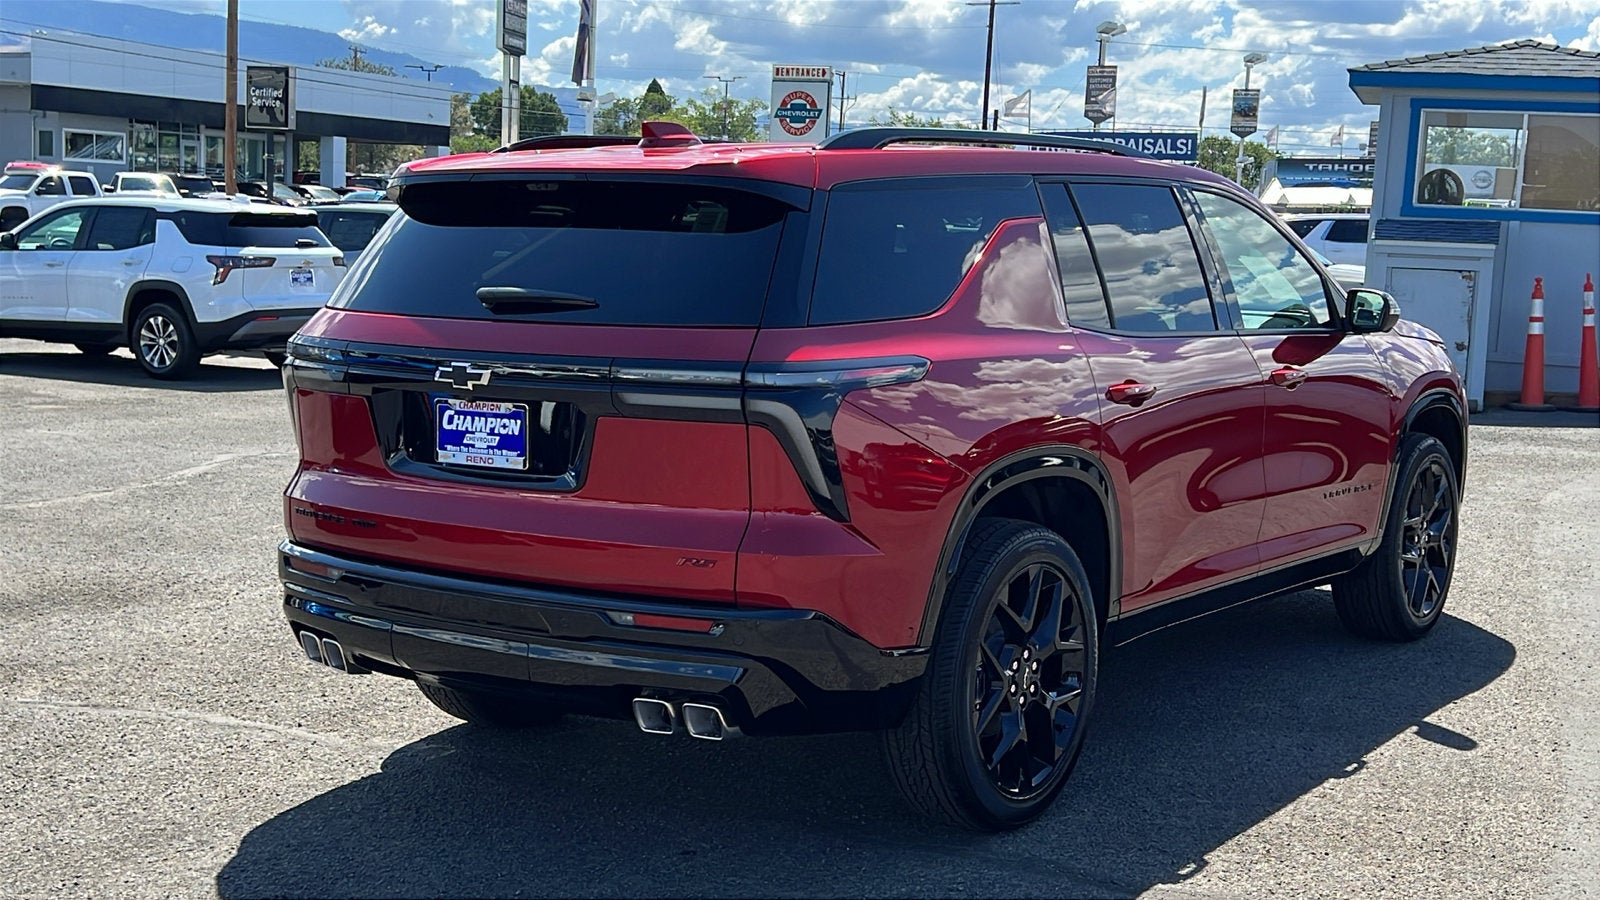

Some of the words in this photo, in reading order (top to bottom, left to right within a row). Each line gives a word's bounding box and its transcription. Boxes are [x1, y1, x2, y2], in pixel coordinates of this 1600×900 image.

[780, 67, 821, 77] ENTRANCE
[250, 87, 283, 97] Certified
[252, 97, 280, 107] Service
[785, 92, 813, 103] SUPER
[782, 120, 814, 135] SERVICE
[459, 403, 501, 411] CHAMPION
[442, 410, 521, 435] CHAMPION
[465, 435, 497, 444] CHEVROLET
[466, 455, 494, 464] RENO
